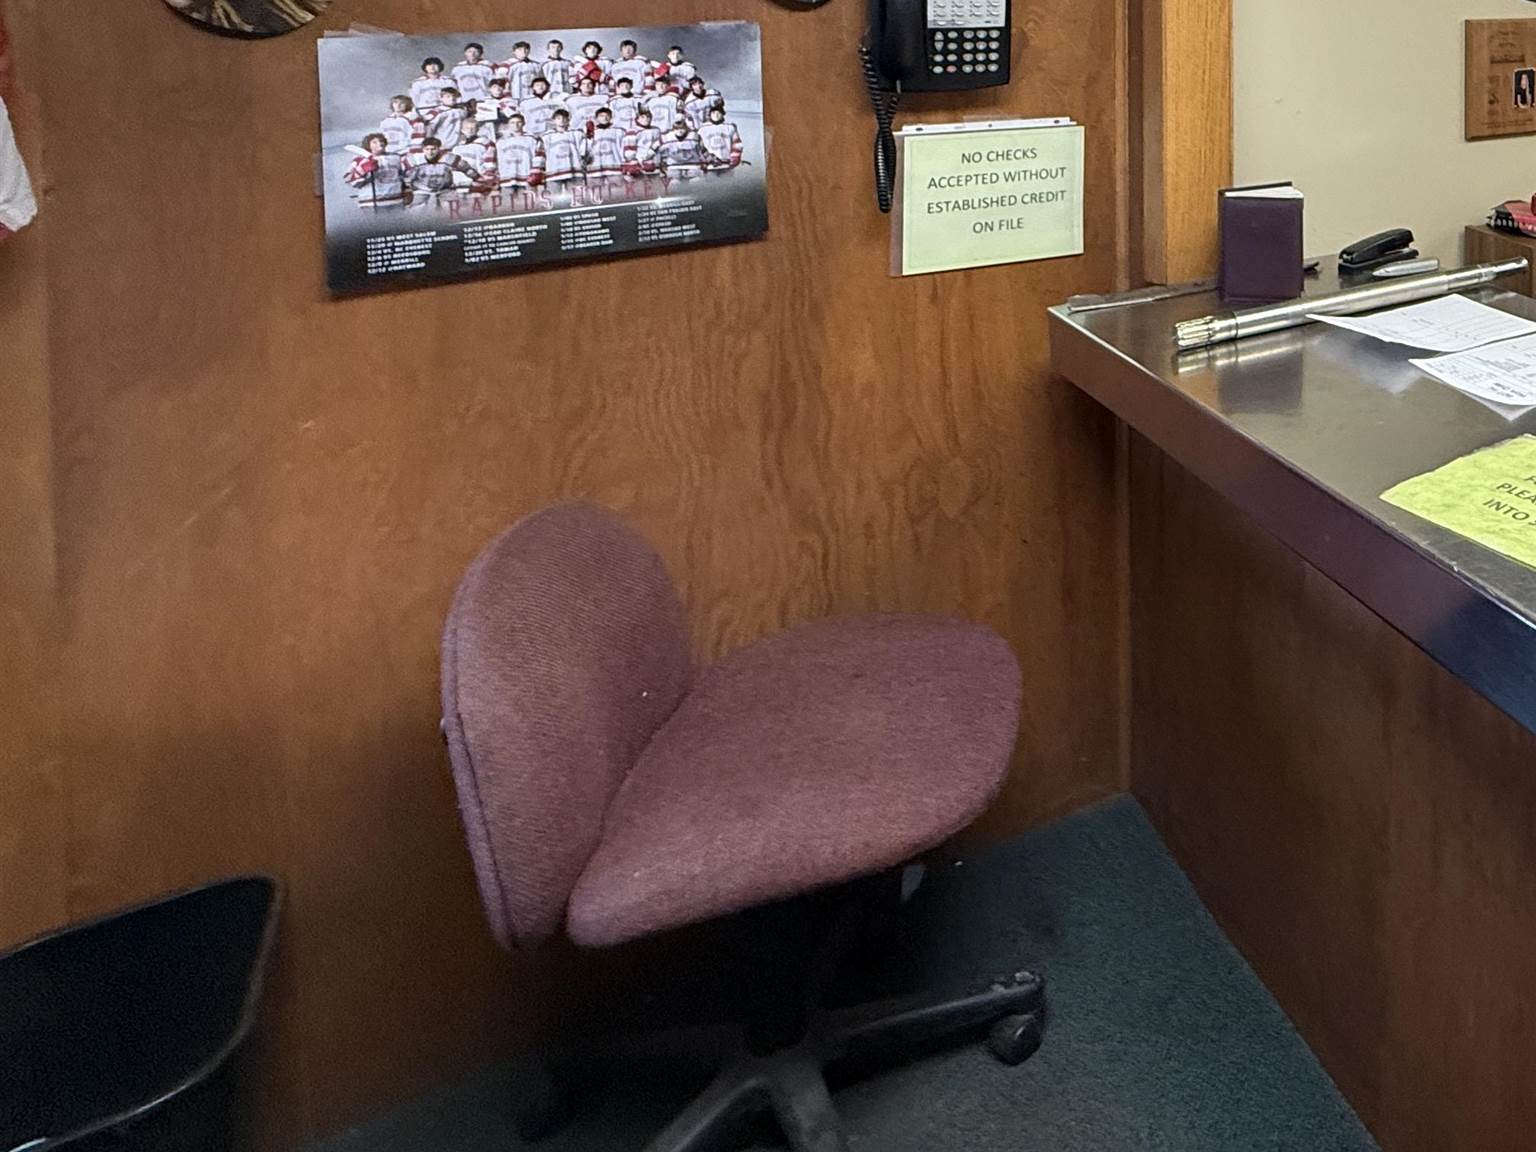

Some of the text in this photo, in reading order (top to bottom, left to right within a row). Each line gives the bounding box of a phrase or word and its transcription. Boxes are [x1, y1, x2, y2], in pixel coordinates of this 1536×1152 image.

[961, 148, 1038, 164] NO CHECKS
[927, 167, 1067, 189] ACCEPTED WITHOUT
[450, 177, 673, 219] RAPIDS HOCKEY
[927, 190, 1067, 214] ESTABLISHED CREDIT
[972, 218, 1024, 234] ON FILE
[1482, 498, 1530, 521] INTO
